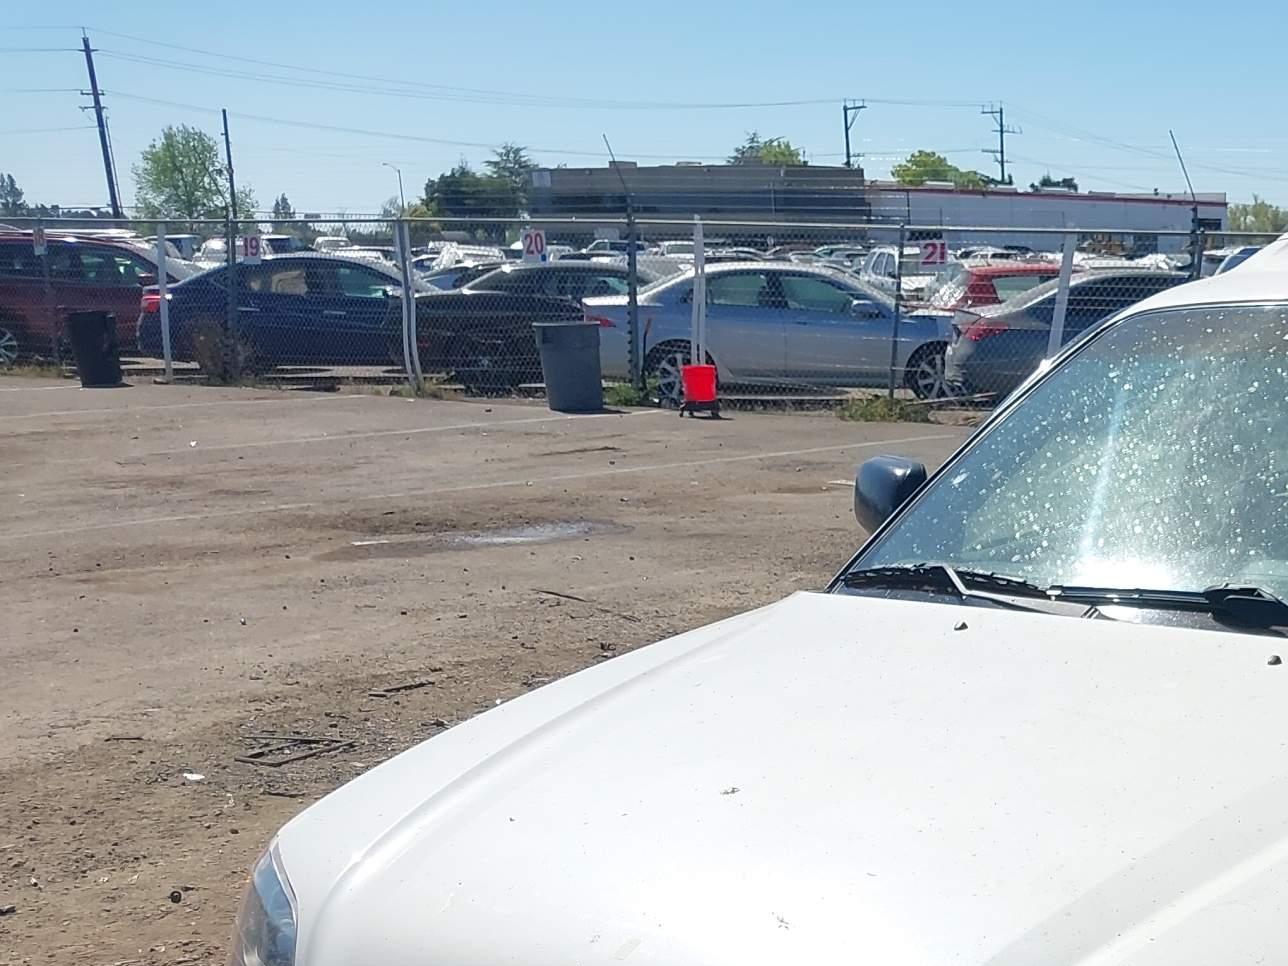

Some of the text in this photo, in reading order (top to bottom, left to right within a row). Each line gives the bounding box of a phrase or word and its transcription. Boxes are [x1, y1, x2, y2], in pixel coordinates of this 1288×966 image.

[243, 236, 260, 257] 19
[524, 232, 544, 256] 20
[922, 242, 946, 265] 21
